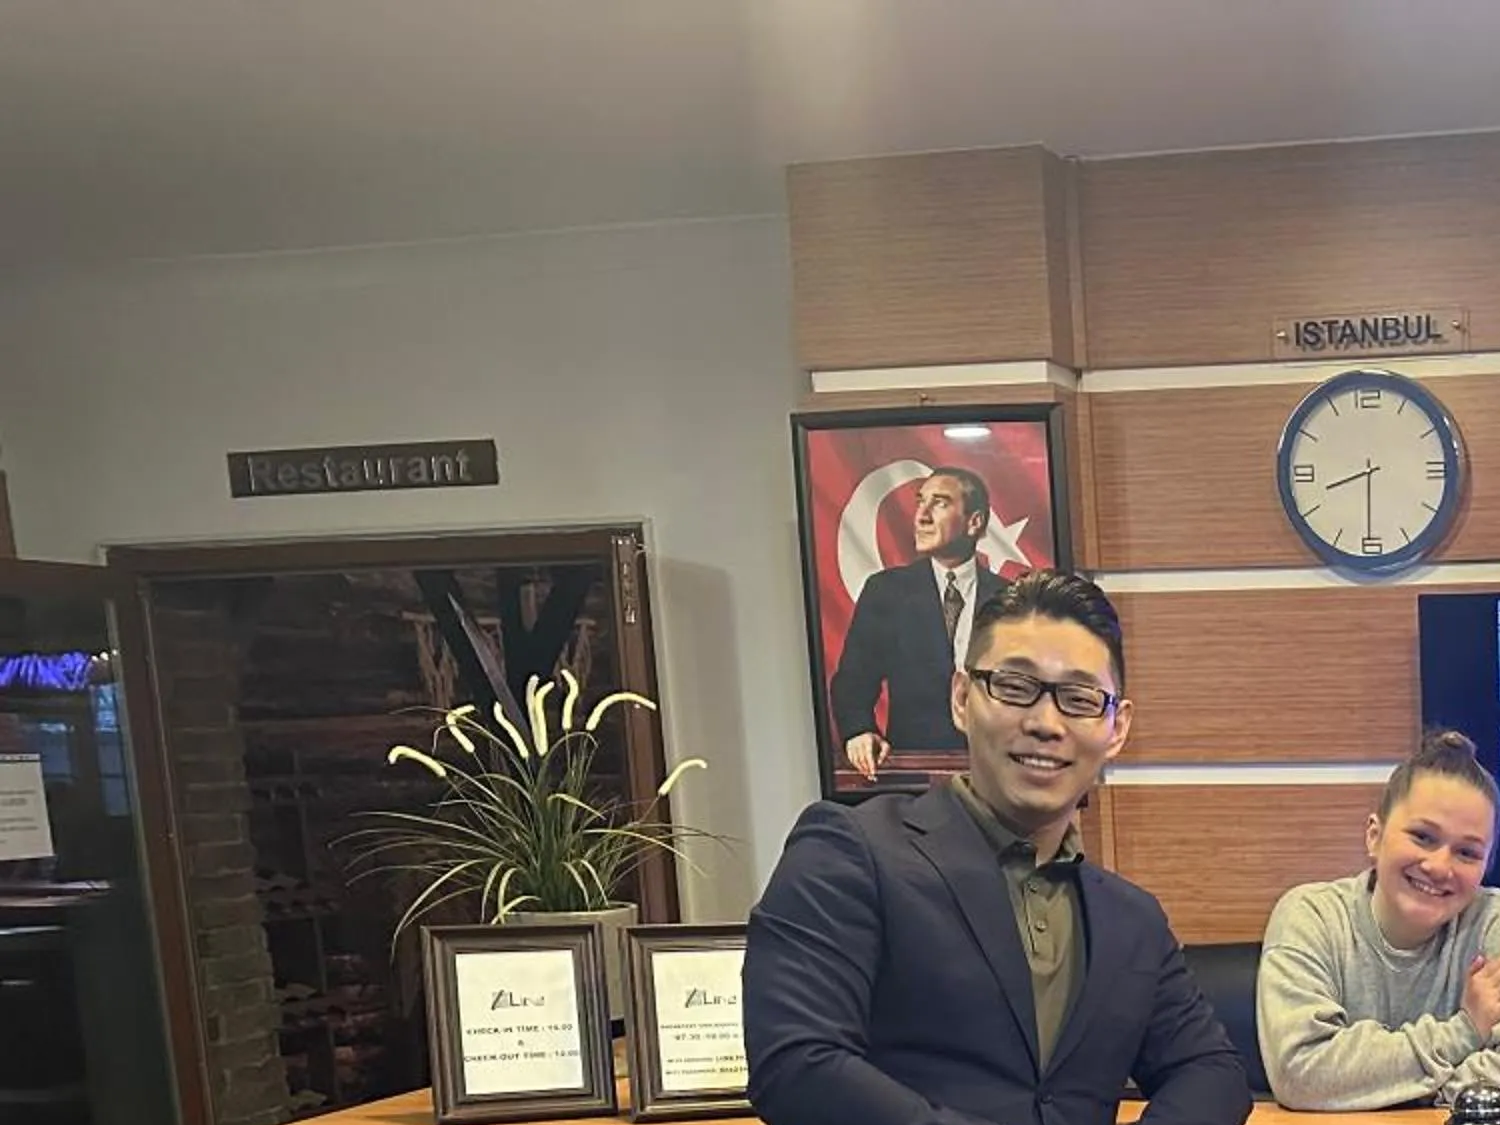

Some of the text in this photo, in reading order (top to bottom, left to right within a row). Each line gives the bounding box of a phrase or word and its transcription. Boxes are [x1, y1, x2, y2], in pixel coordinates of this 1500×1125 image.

[1293, 314, 1443, 348] ISTANBUL
[1355, 389, 1381, 408] 12
[248, 448, 473, 492] Restaurant
[1293, 464, 1315, 483] 9
[1425, 461, 1447, 480] 3
[1362, 537, 1383, 555] 6
